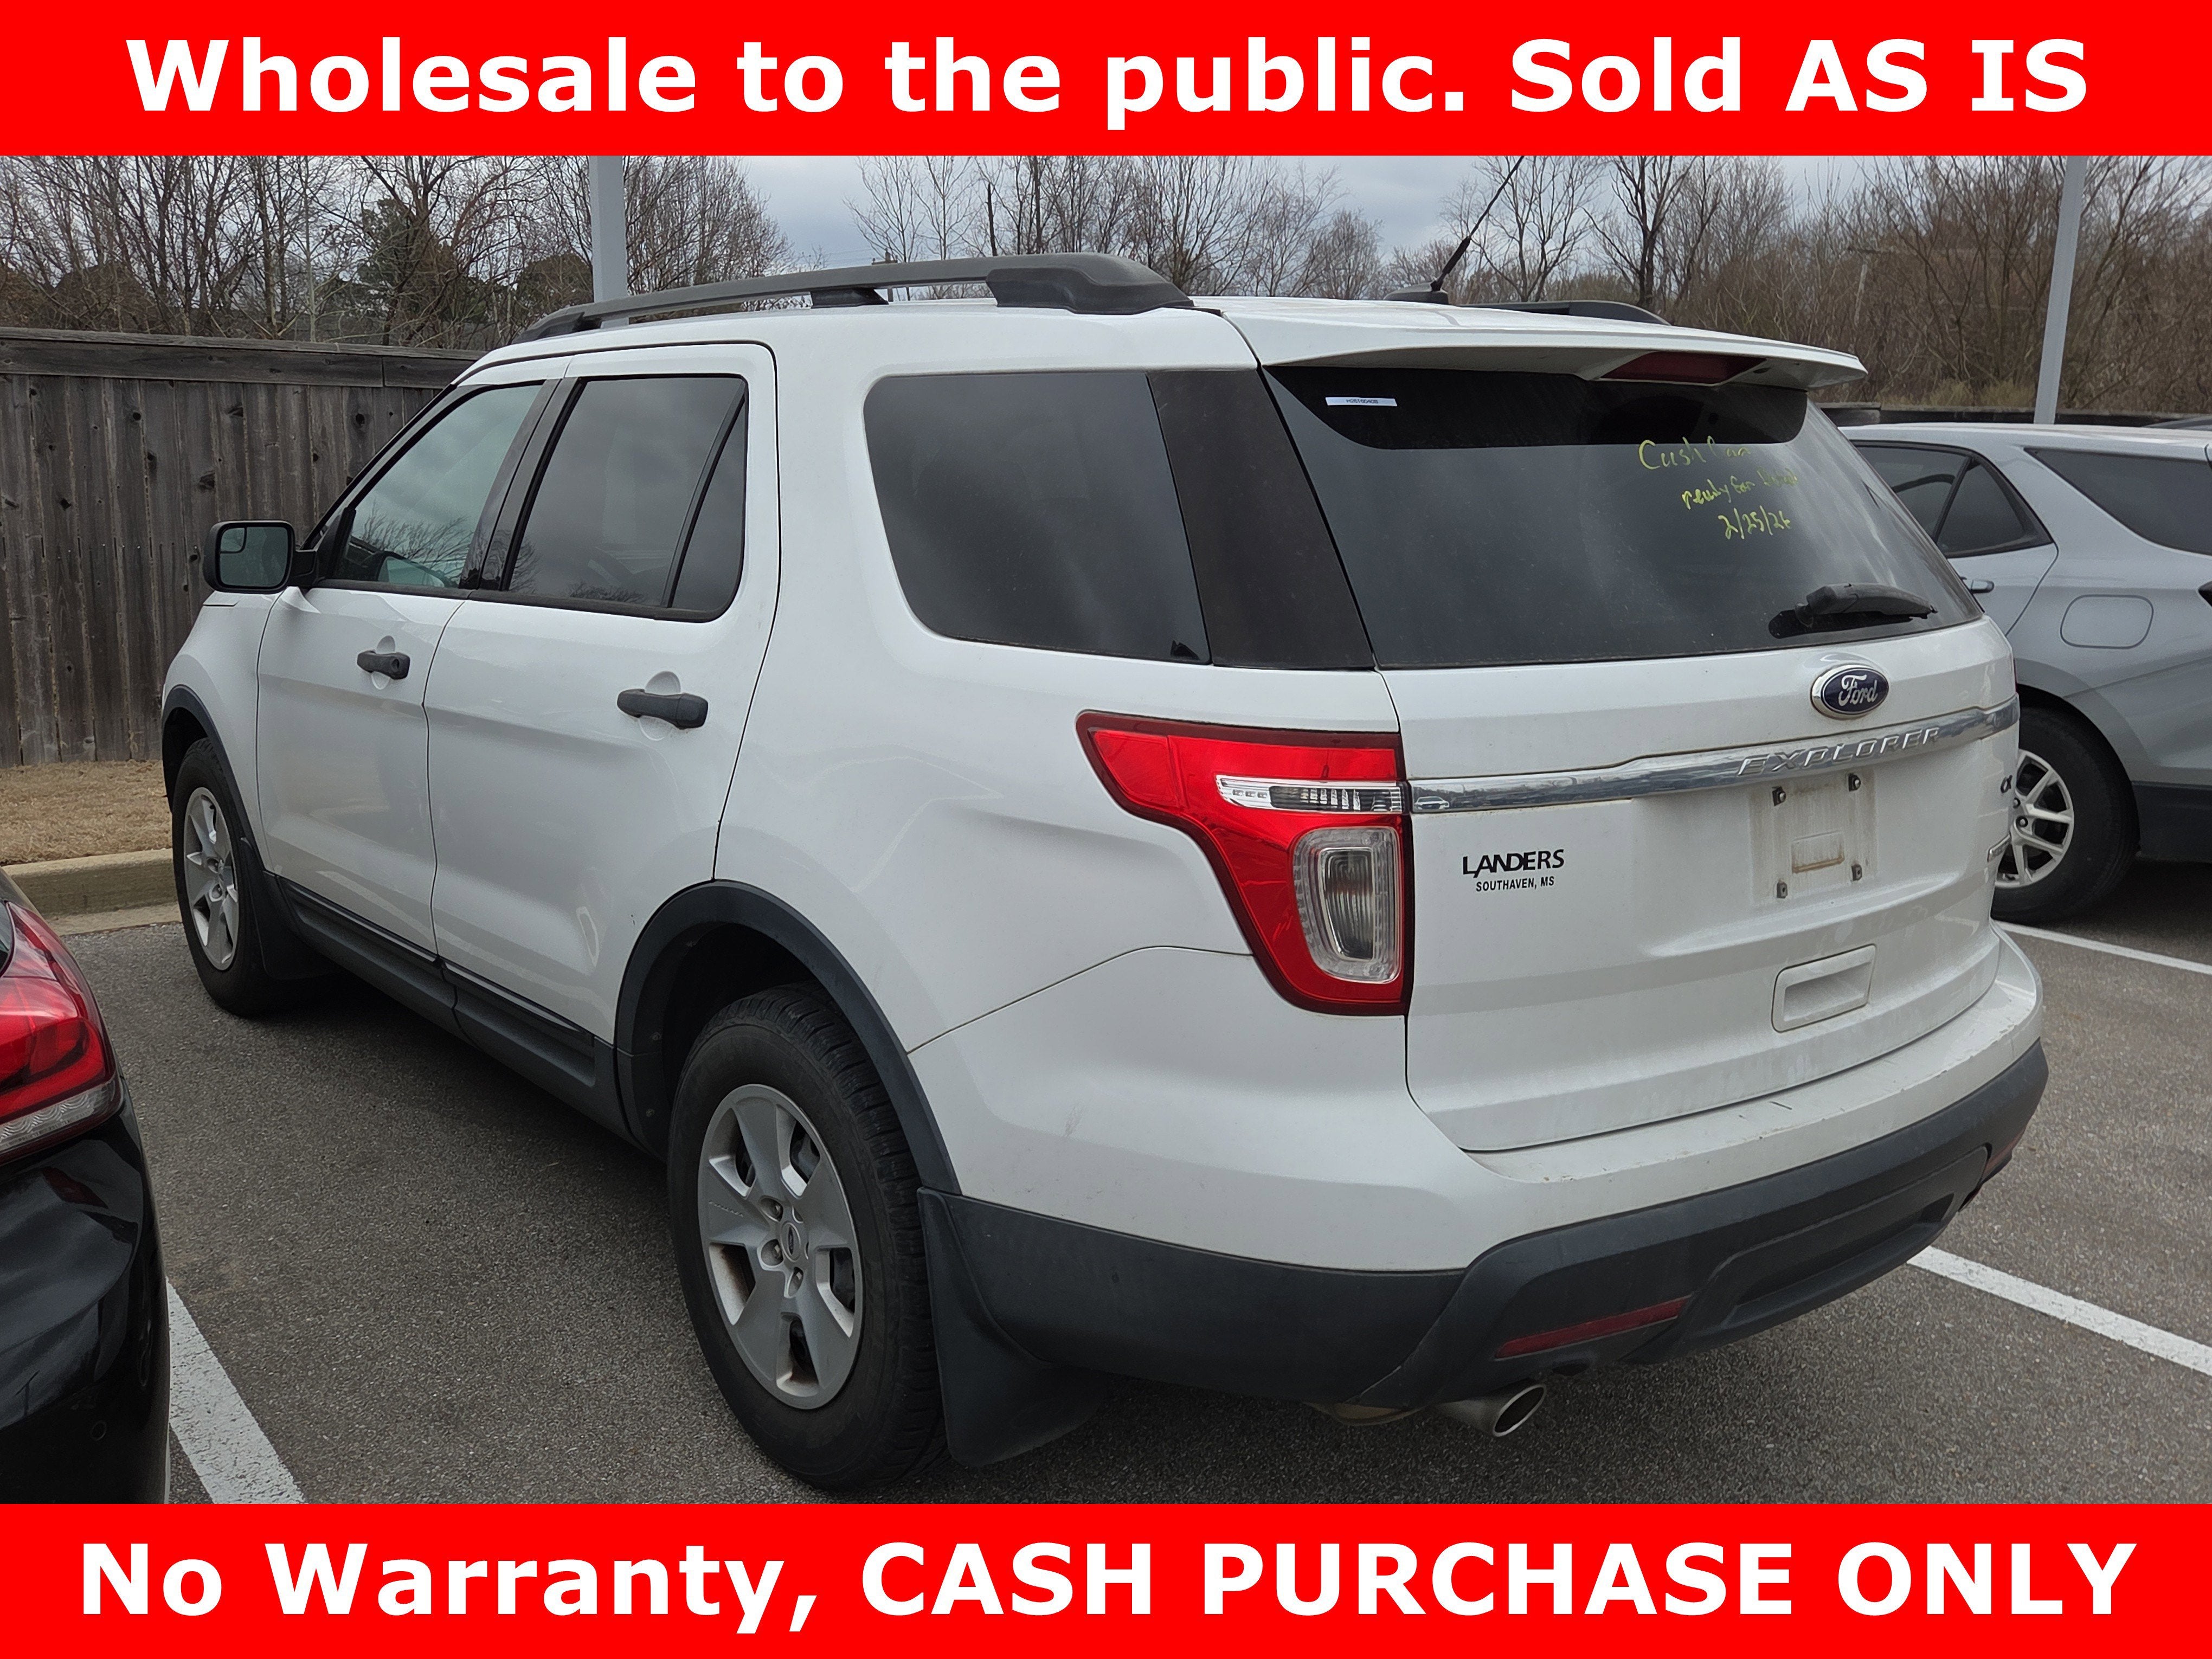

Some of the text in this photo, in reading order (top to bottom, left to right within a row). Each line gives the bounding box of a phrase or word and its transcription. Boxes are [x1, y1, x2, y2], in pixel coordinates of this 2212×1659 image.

[1837, 674, 1878, 706] Ford
[1737, 727, 1941, 776] EXPLORER
[1463, 848, 1565, 879] LANDERS
[1475, 876, 1555, 892] SOUTHAVEN, MS
